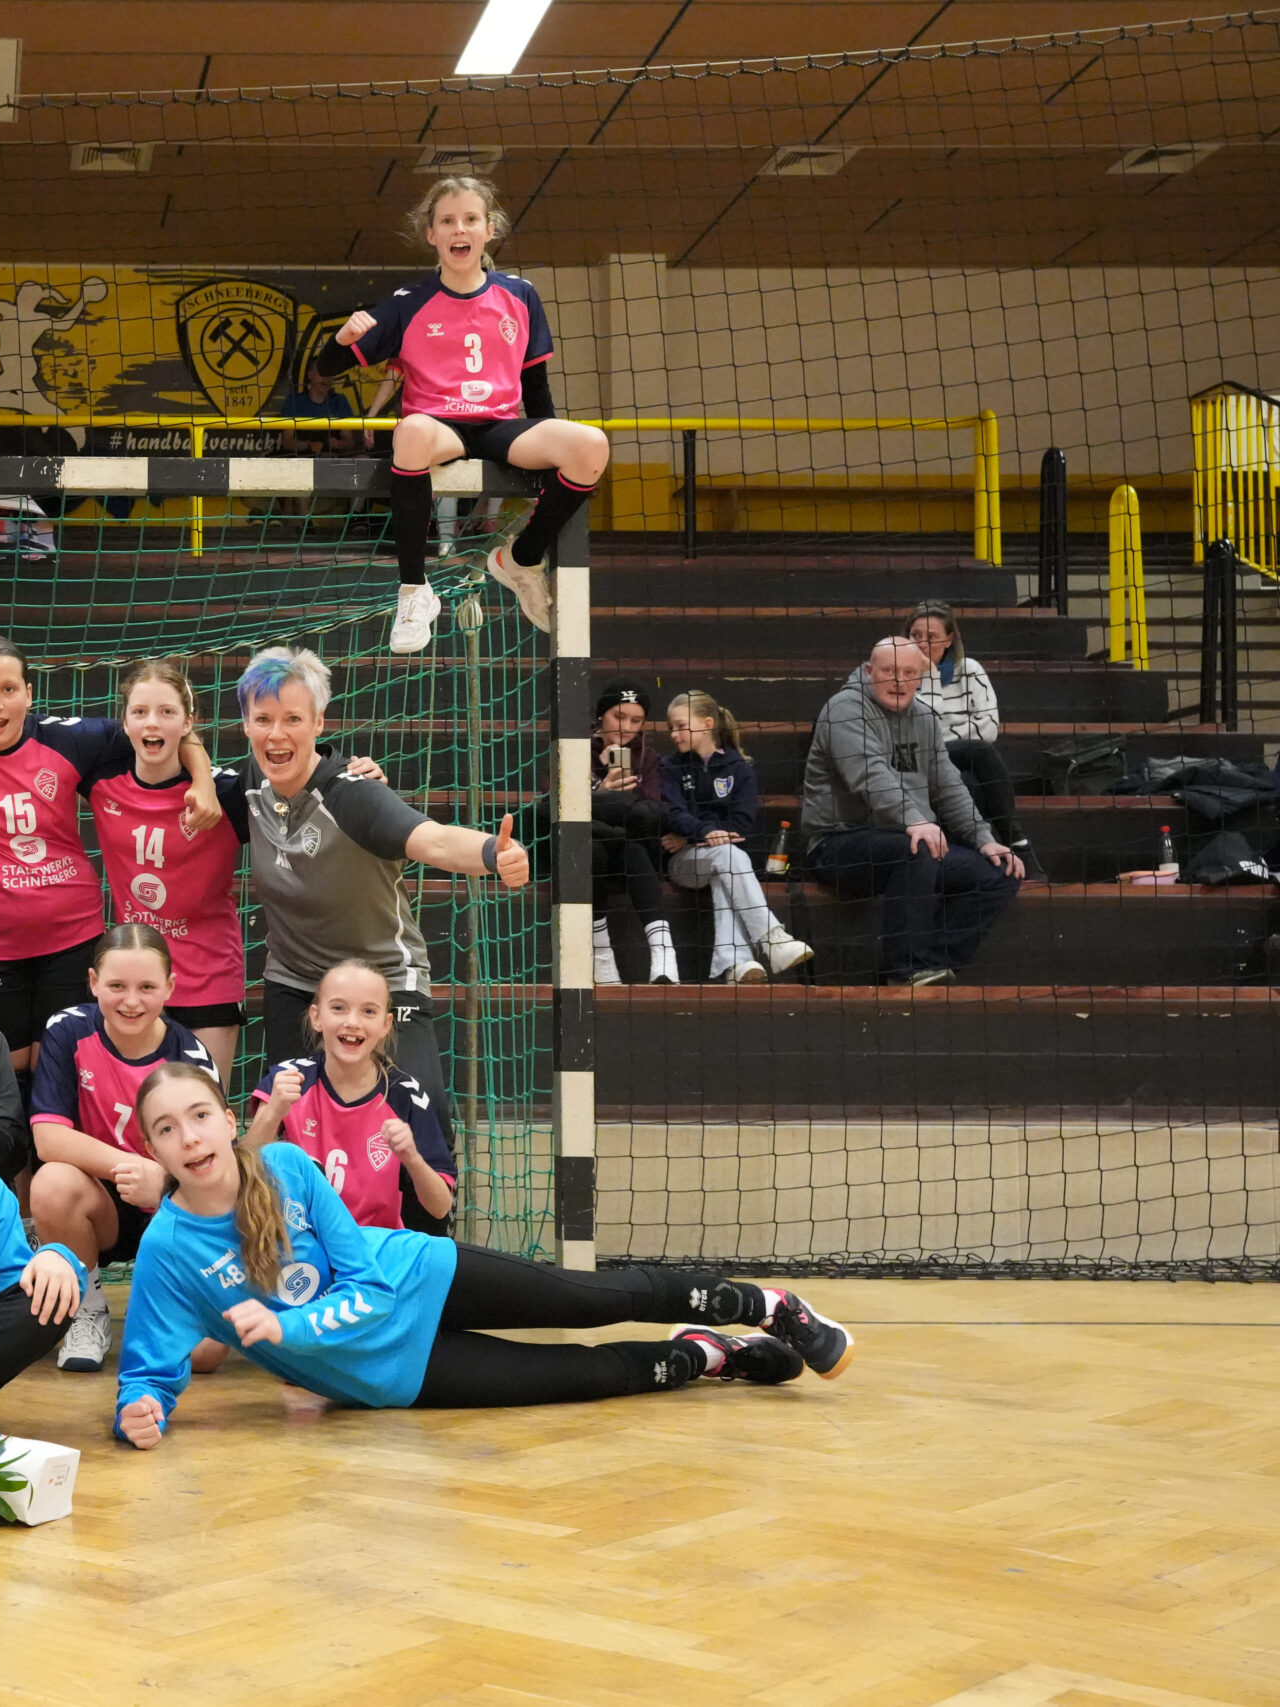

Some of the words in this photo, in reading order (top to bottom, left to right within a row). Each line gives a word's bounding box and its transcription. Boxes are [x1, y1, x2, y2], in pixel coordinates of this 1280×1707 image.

[186, 287, 283, 309] SCHNEEBERG
[464, 333, 483, 373] 3
[225, 396, 253, 408] 1847
[229, 384, 248, 394] seit
[132, 824, 165, 869] 14
[113, 1102, 133, 1146] 7
[324, 1148, 349, 1196] 6
[200, 1248, 237, 1278] hummel
[218, 1264, 247, 1290] 48
